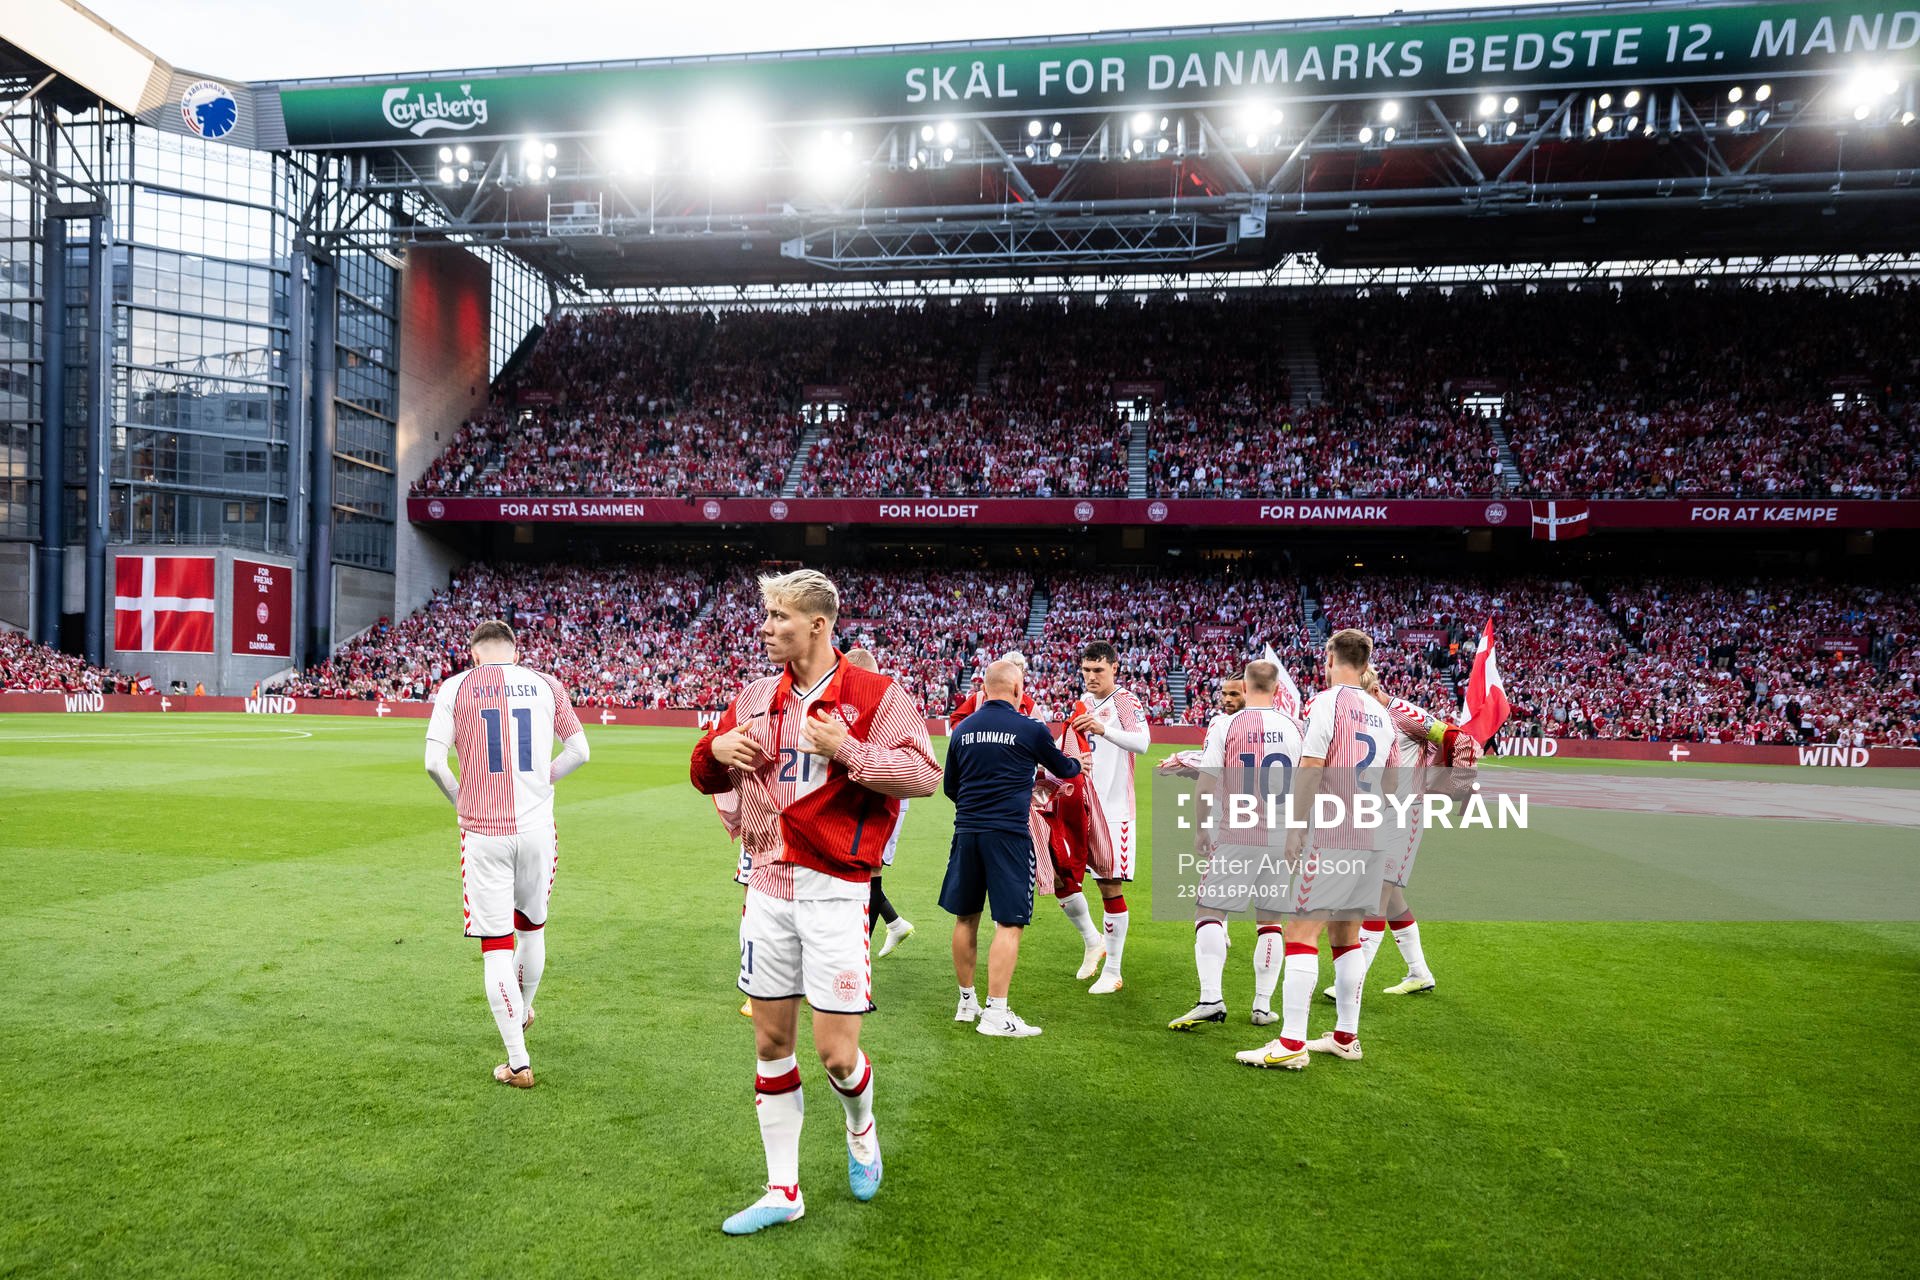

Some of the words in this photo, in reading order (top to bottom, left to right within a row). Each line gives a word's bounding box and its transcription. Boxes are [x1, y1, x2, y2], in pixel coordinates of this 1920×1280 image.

[906, 61, 1018, 102] SKÅL
[1039, 57, 1125, 96] FOR
[1148, 40, 1423, 90] DANMARKS
[1446, 27, 1643, 74] BEDSTE
[1665, 23, 1725, 63] 12.
[1750, 11, 1920, 58] MAND
[382, 84, 488, 137] Carlsberg
[500, 504, 528, 516] FOR
[531, 504, 549, 516] AT
[552, 502, 578, 516] STÅ
[581, 504, 644, 517] SAMMEN
[879, 504, 911, 517] FOR
[914, 504, 979, 518] HOLDET
[1260, 505, 1295, 519] FOR
[1299, 505, 1387, 520] DANMARK
[1691, 507, 1730, 521] FOR
[1733, 507, 1760, 521] AT
[1763, 507, 1838, 521] KÆMPE
[257, 567, 269, 576] FOR
[249, 641, 275, 651] DANMARK
[256, 633, 268, 642] FOR
[504, 684, 538, 697] OLSEN
[64, 693, 104, 713] WIND
[244, 697, 296, 714] WIND
[480, 707, 534, 773] 11
[961, 732, 975, 746] FOR
[976, 731, 1017, 746] DANMARK
[1497, 737, 1558, 756] WIND
[778, 748, 811, 782] 21
[1355, 732, 1377, 792] 2
[1798, 747, 1870, 768] WIND
[1239, 752, 1293, 805] 10
